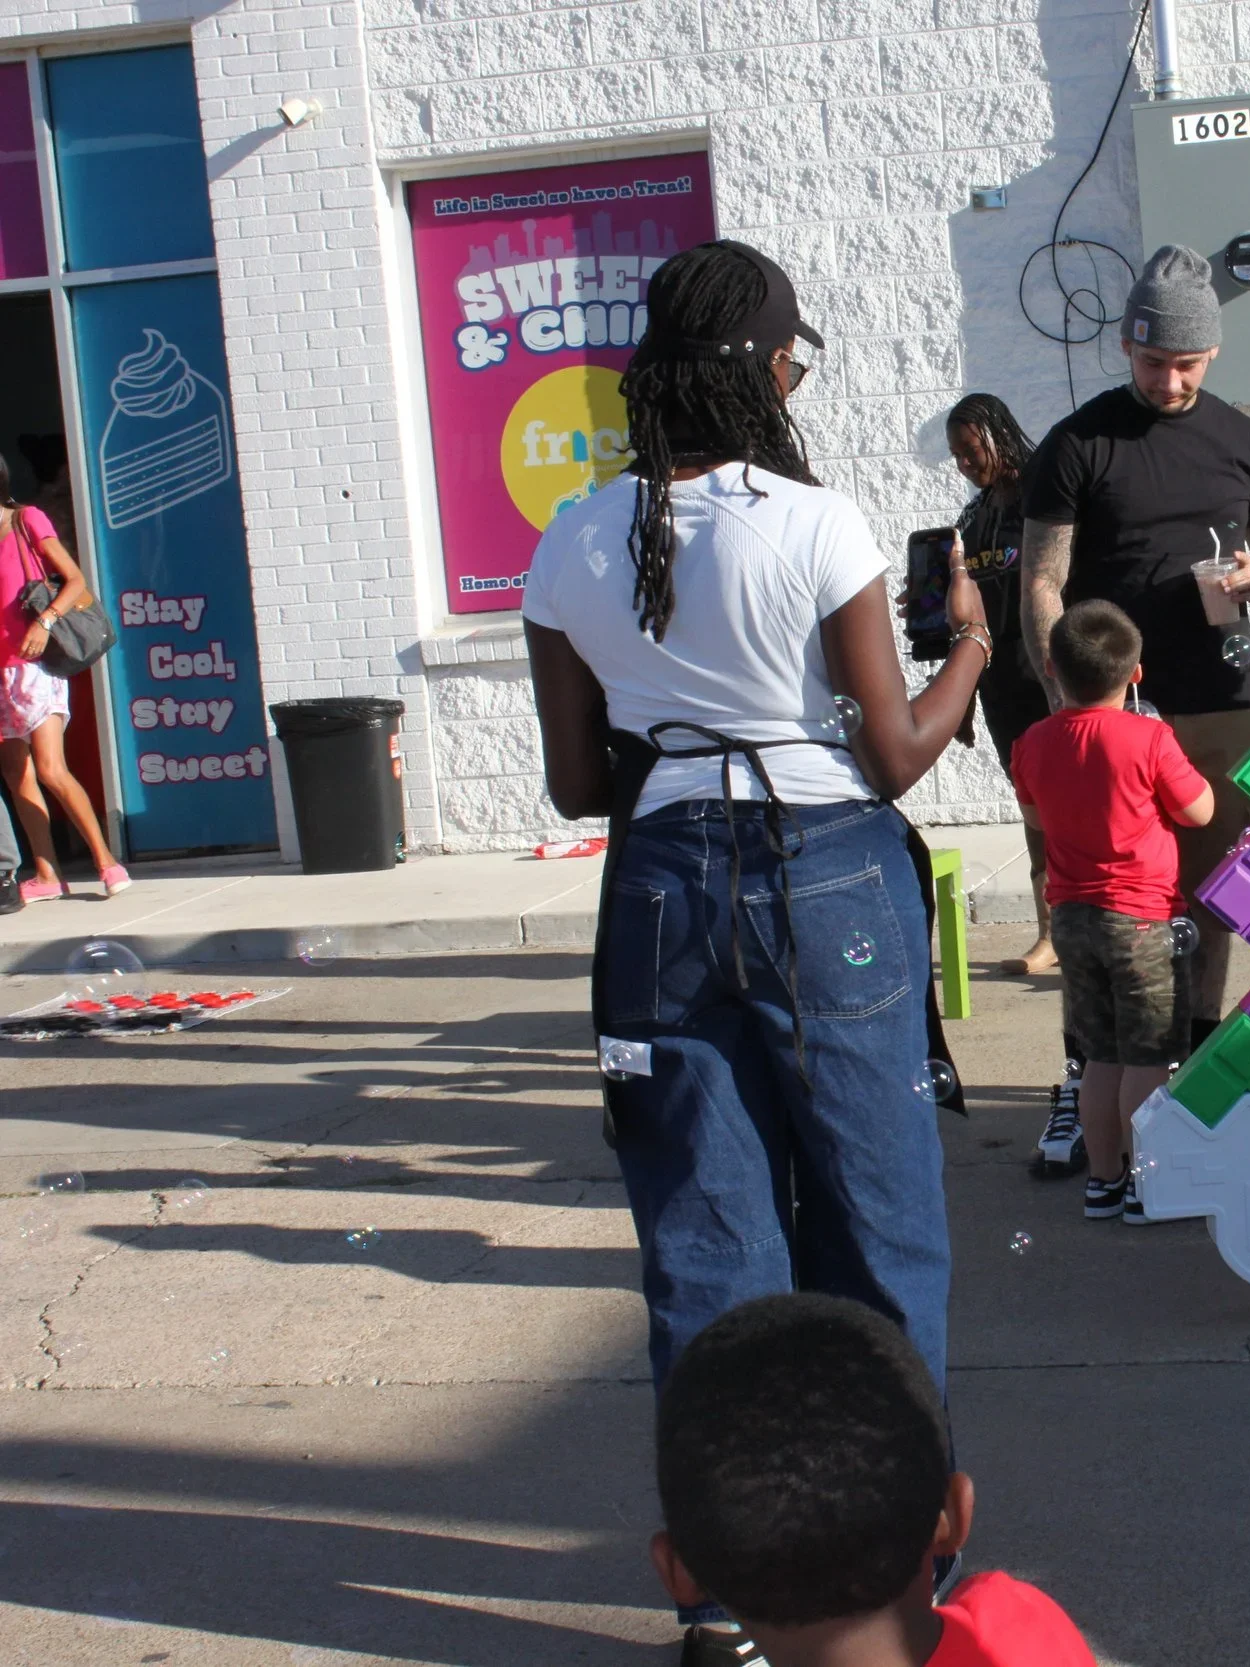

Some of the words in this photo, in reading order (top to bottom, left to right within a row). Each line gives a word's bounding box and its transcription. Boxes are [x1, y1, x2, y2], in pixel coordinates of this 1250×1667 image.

[1178, 112, 1248, 141] 1602
[434, 198, 470, 216] Life
[471, 197, 490, 212] is
[491, 191, 546, 210] Sweet
[548, 192, 569, 205] so
[571, 186, 617, 203] have
[619, 186, 633, 198] a
[634, 176, 692, 197] Treat!
[456, 324, 509, 370] &
[459, 576, 510, 592] Home
[121, 592, 205, 631] Stay
[149, 641, 236, 680] Cool,
[132, 697, 234, 733] Stay
[139, 746, 268, 783] Sweet
